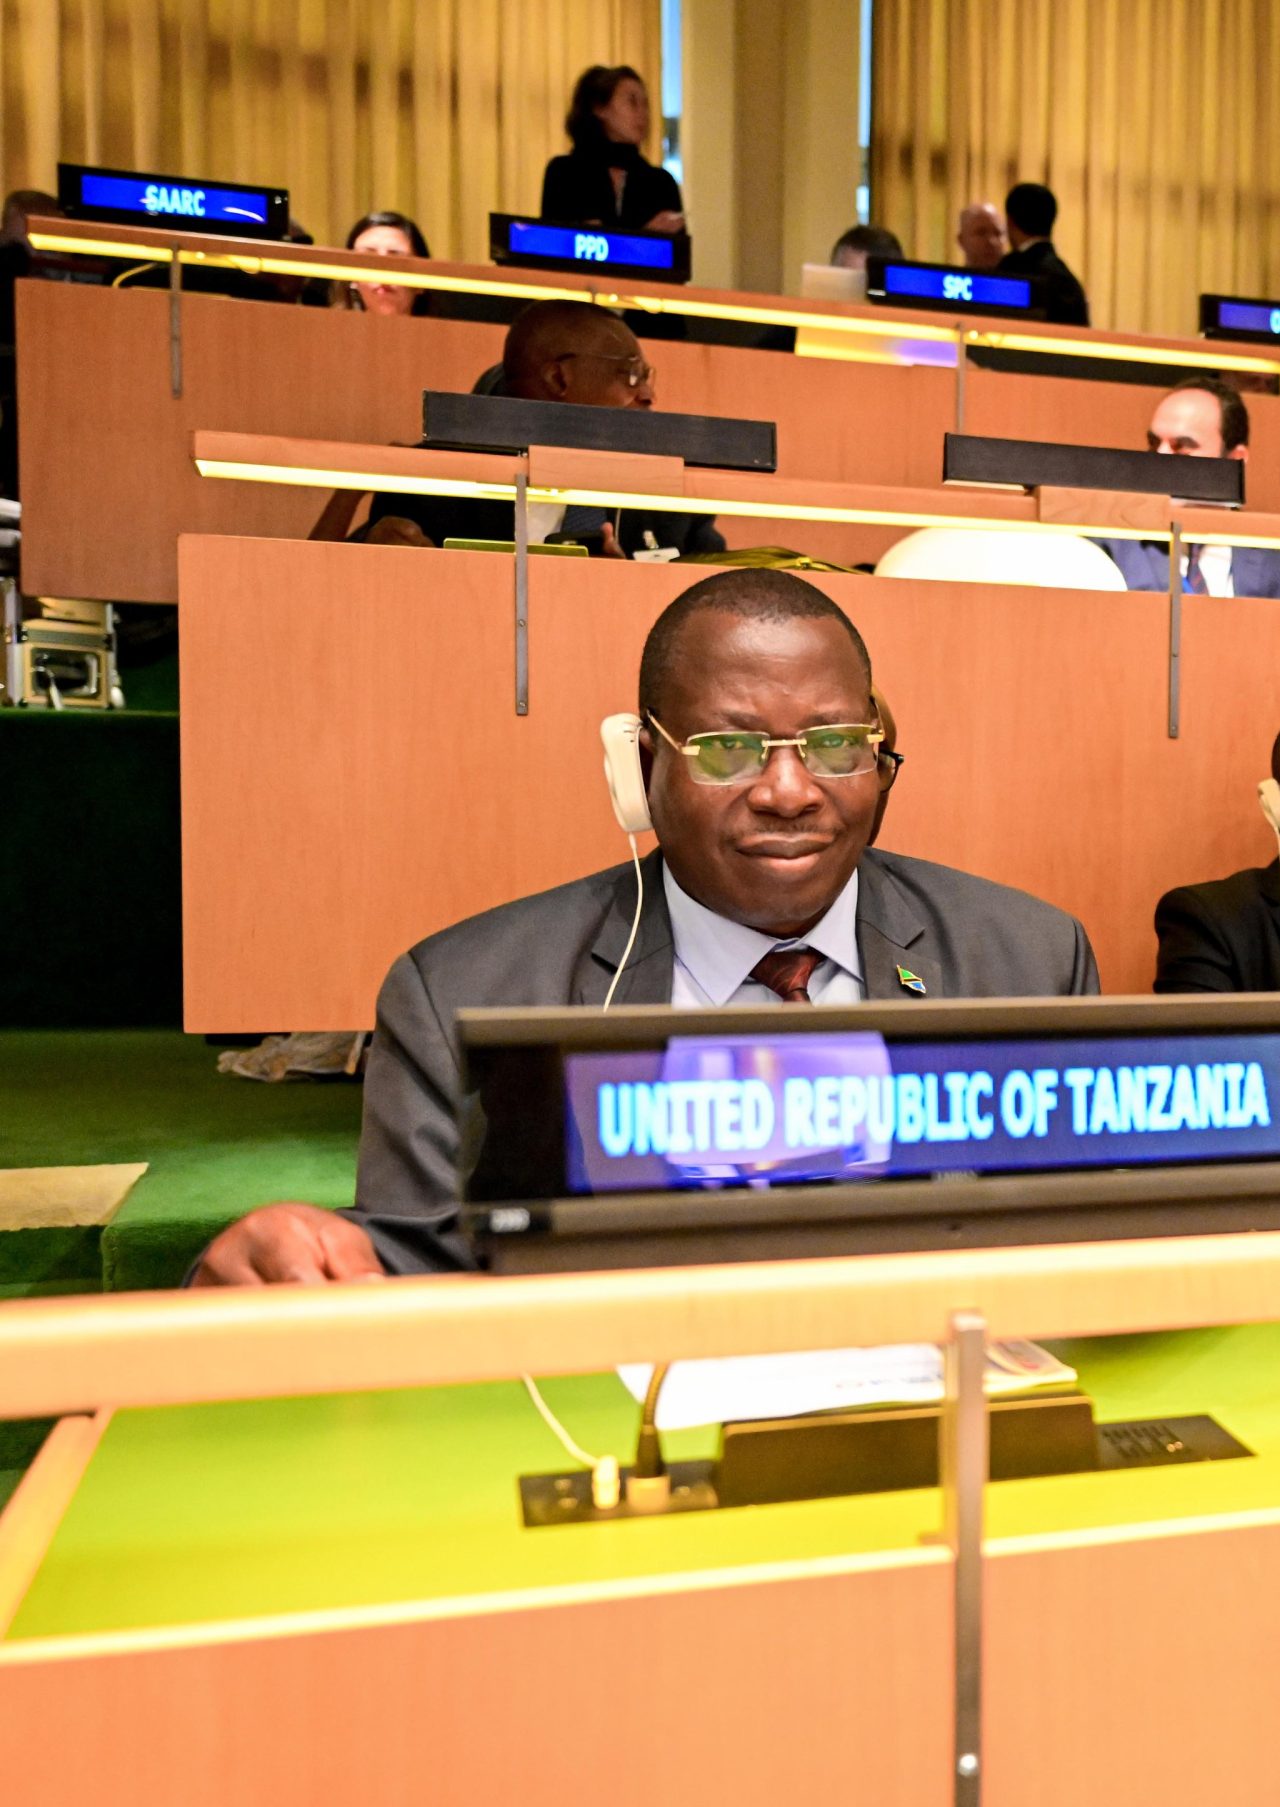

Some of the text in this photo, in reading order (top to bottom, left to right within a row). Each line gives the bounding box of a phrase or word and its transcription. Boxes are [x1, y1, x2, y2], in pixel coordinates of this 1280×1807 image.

[145, 185, 206, 217] SAARC
[574, 233, 609, 261] PPD
[943, 274, 973, 301] SPC
[598, 1062, 1271, 1158] UNITED REPUBLIC OF TANZANIA
